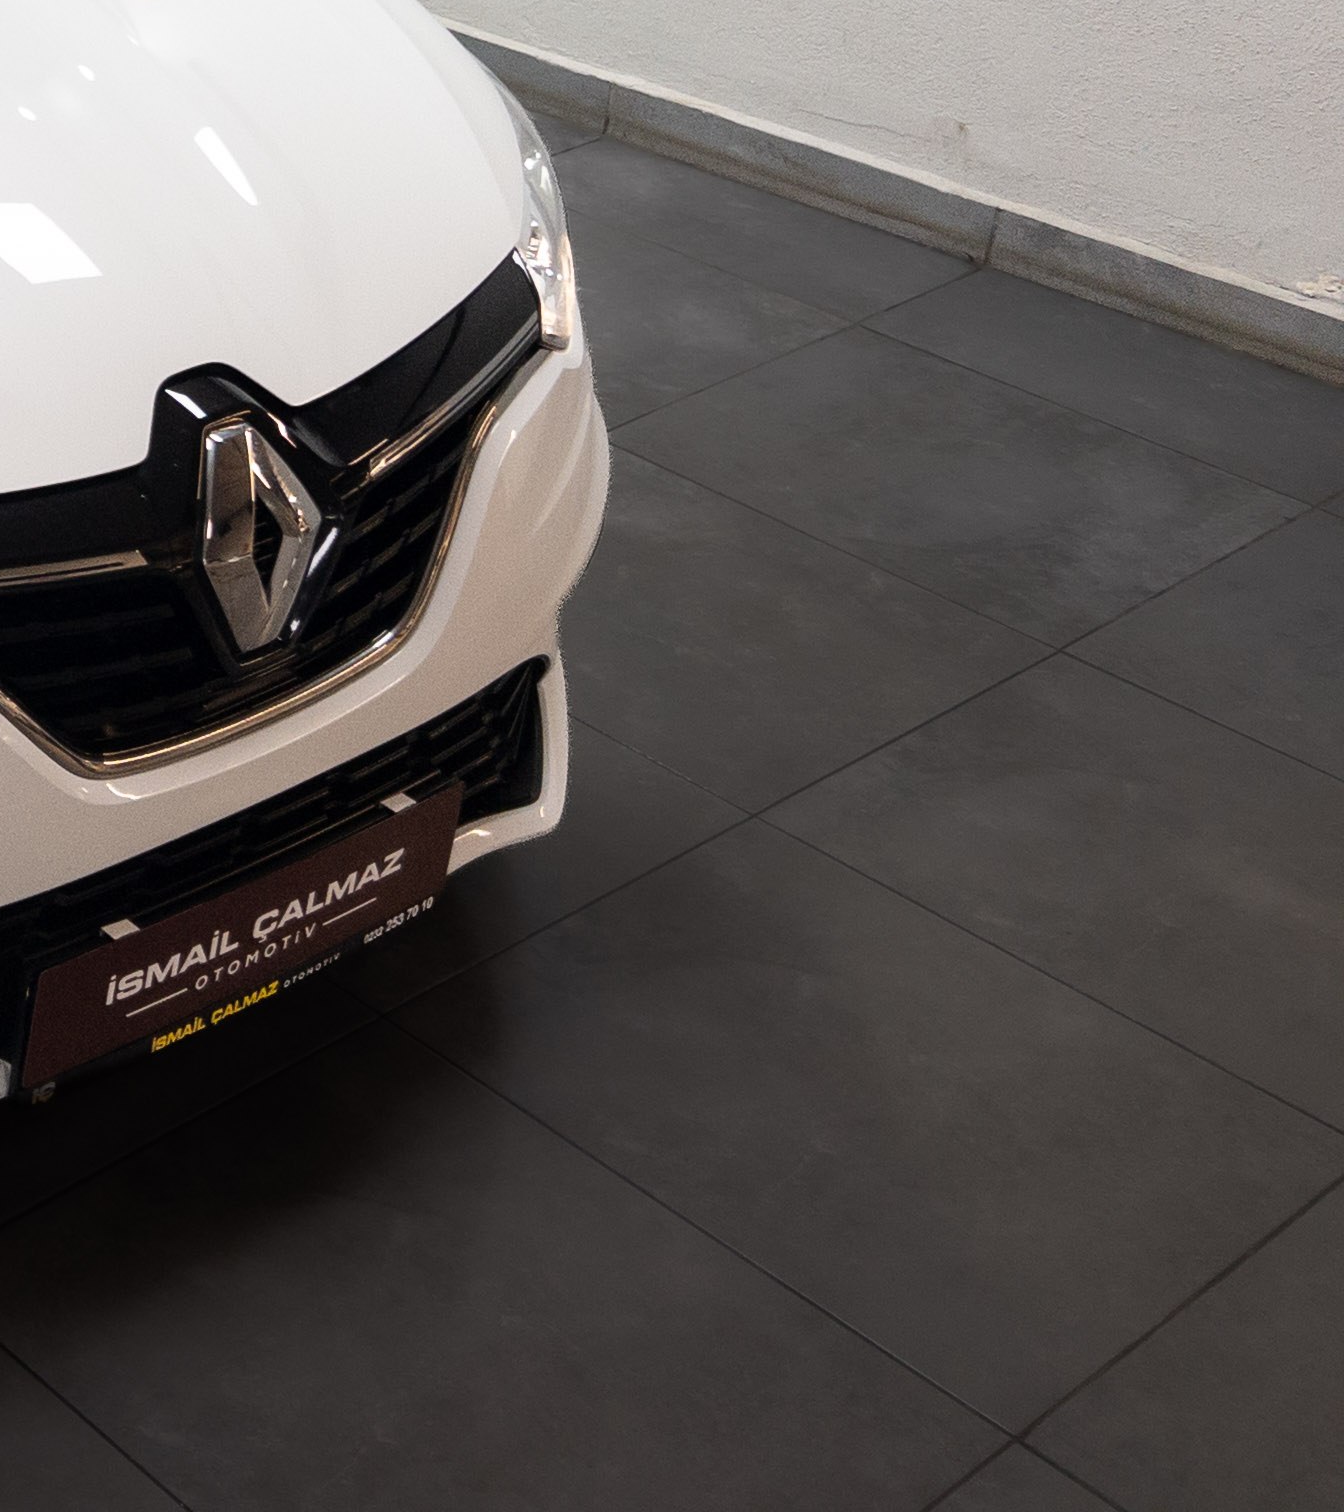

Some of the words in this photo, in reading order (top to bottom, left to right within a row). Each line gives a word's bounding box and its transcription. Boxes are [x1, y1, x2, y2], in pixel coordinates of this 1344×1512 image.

[252, 847, 405, 944] ÇALMAZ
[385, 912, 405, 933] 253
[406, 904, 420, 921] 70
[421, 895, 434, 912] 10
[210, 980, 280, 1026] ÇALMAZ
